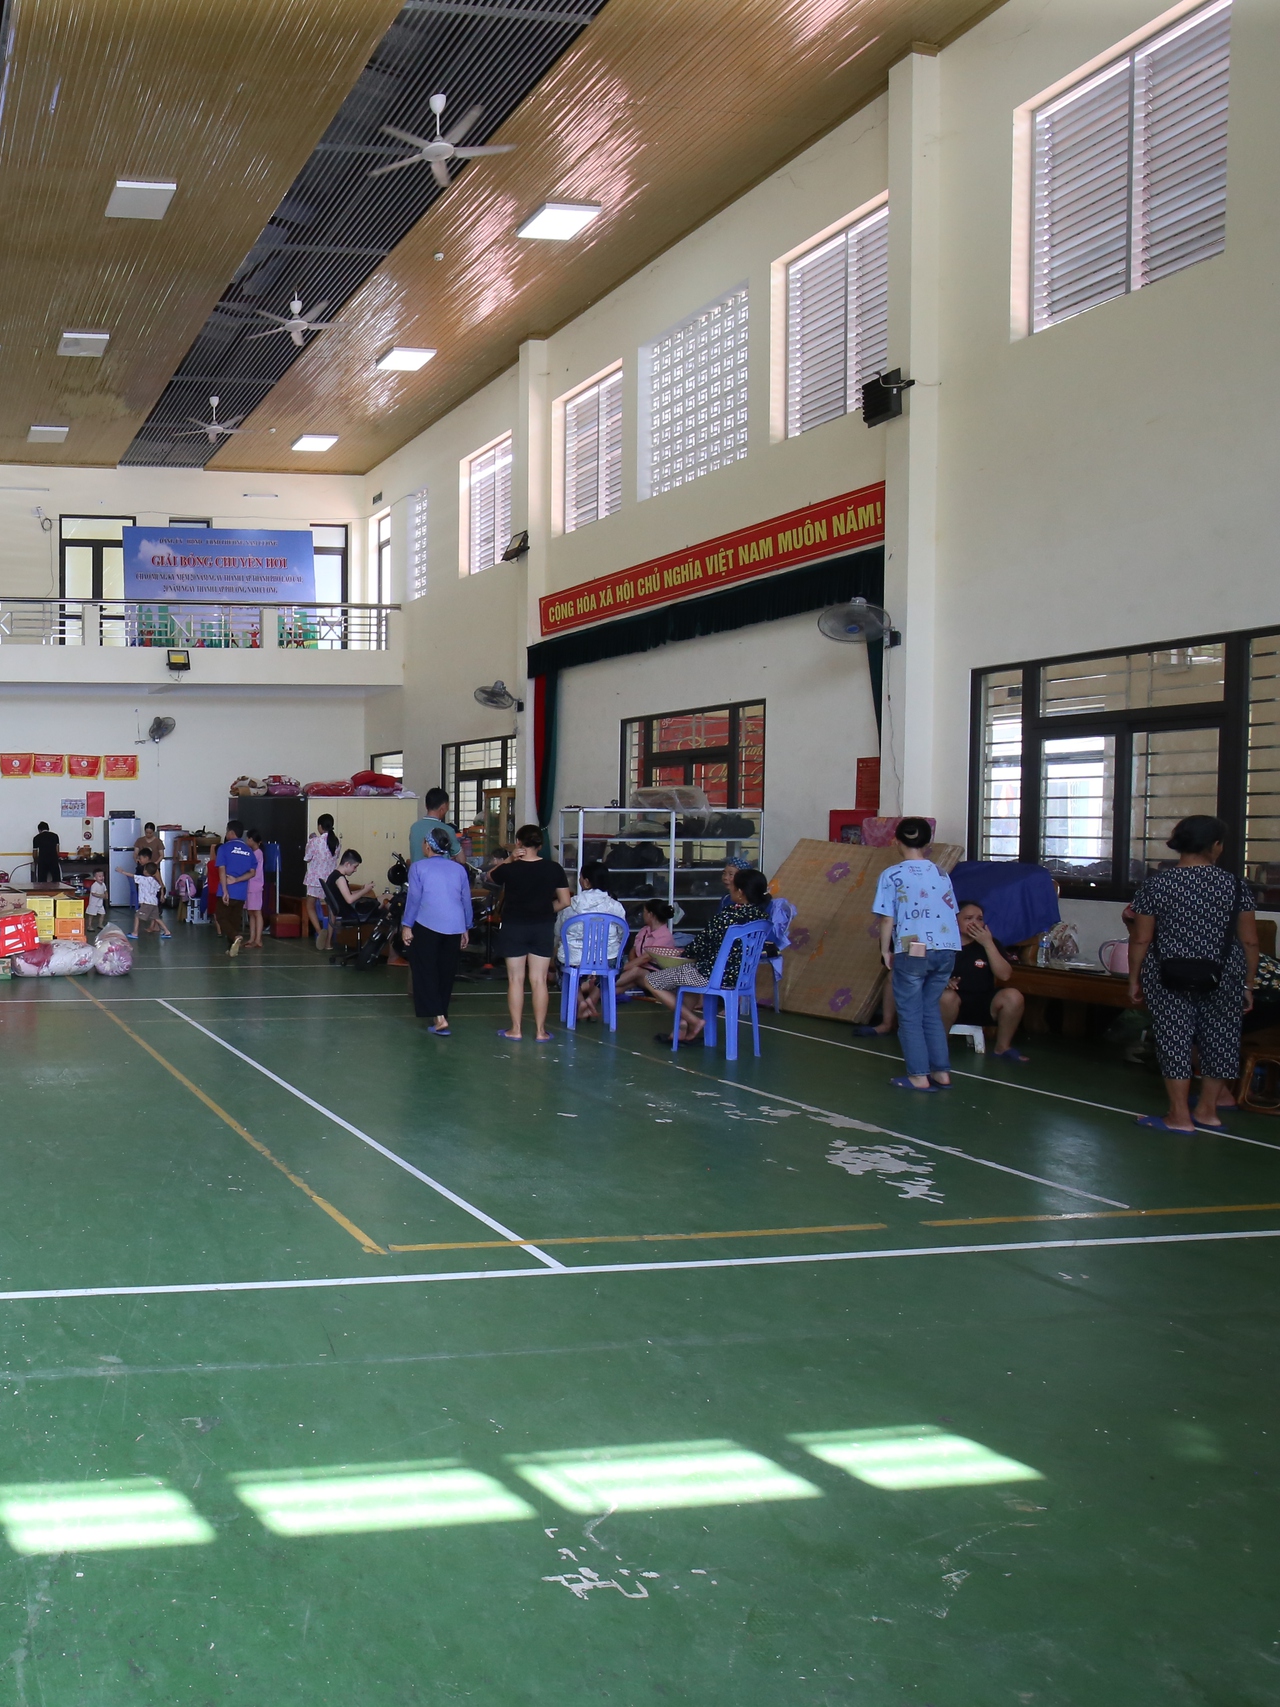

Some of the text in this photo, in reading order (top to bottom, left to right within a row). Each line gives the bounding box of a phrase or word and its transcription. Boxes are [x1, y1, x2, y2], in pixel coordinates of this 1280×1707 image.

[151, 552, 288, 569] GIẢI BÓNG CHUYỀN HƠI
[548, 501, 882, 625] CỘNG HÒA XÃ HỘI CHỦ NGHĨA VIỆT NAM MUÔN NĂM!
